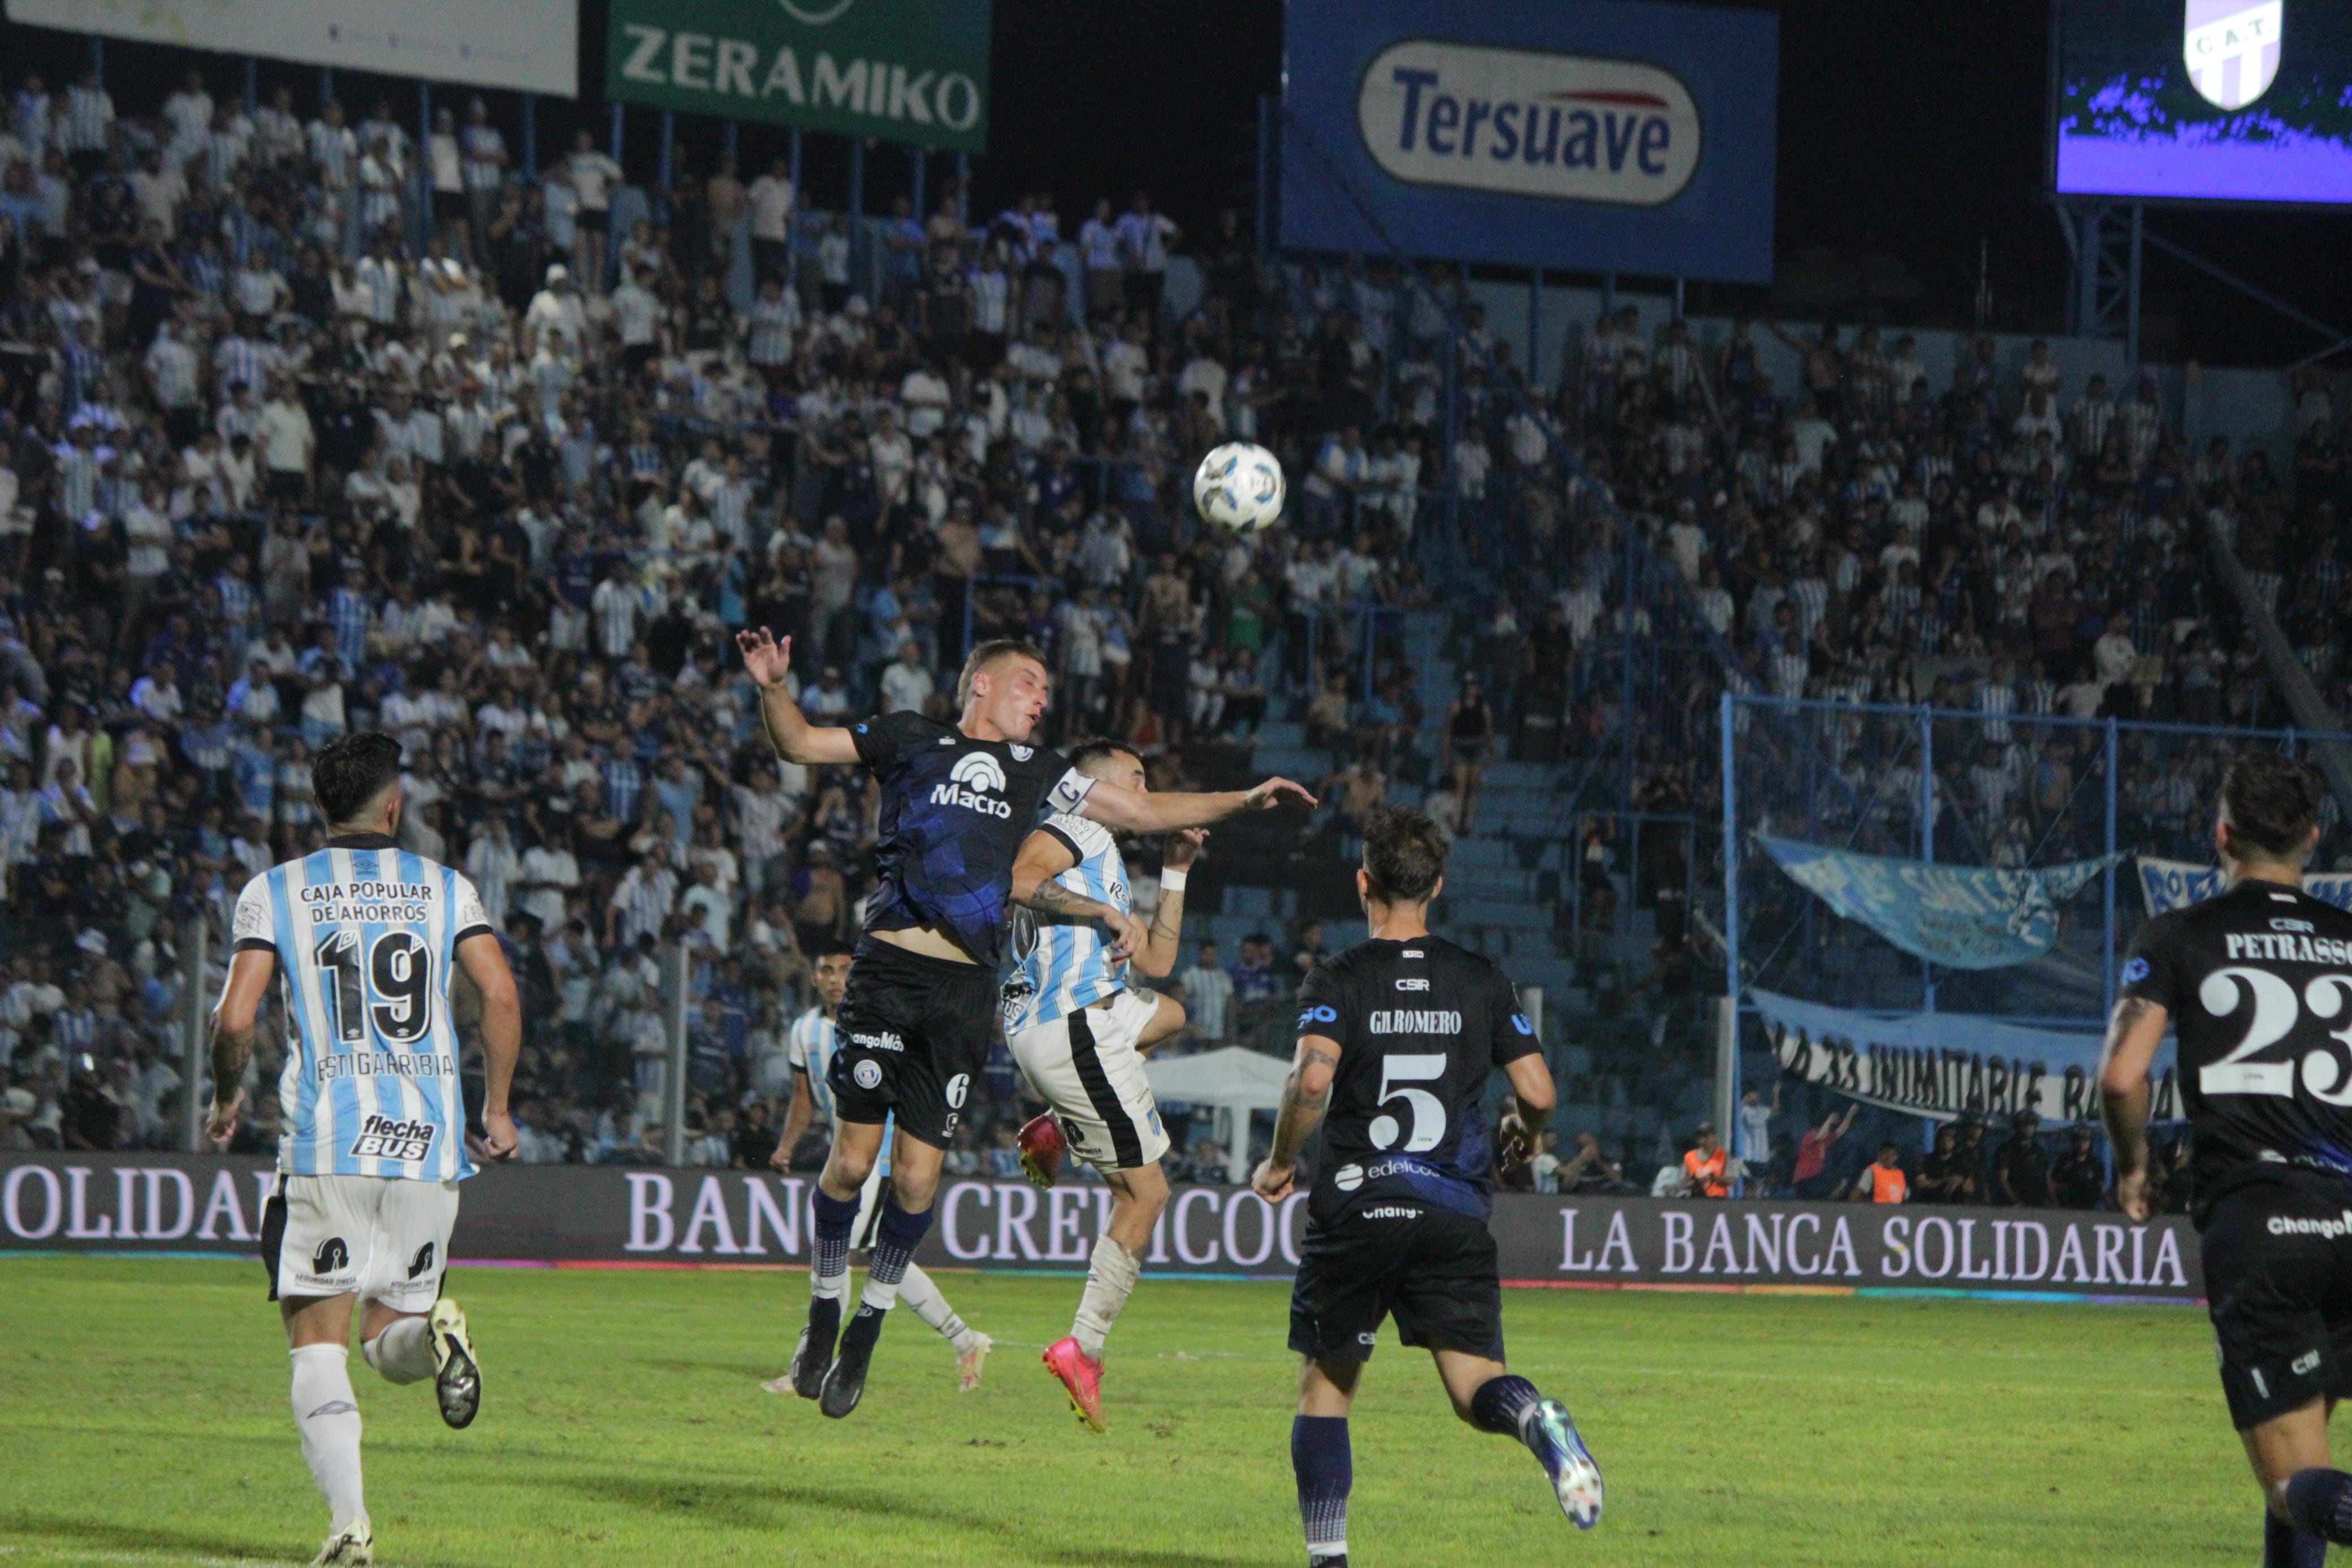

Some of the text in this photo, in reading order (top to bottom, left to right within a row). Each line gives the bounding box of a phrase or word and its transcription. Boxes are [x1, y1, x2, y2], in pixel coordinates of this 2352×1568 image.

[622, 24, 980, 131] ZERAMIKO
[1393, 67, 1671, 176] Tersuave
[930, 783, 1011, 819] Macro
[1059, 781, 1079, 802] C
[300, 882, 433, 903] CAJA POPULAR
[312, 905, 427, 923] DE AHORROS
[314, 930, 434, 1043] 19
[2199, 966, 2352, 1106] 23
[318, 1053, 455, 1081] ESTIGARRIBIA
[946, 1073, 970, 1109] 6
[1369, 1052, 1447, 1152] 5
[364, 1115, 434, 1141] flecha
[358, 1137, 424, 1160] BUS
[1559, 1209, 2188, 1287] LA BANCA SOLIDARIA
